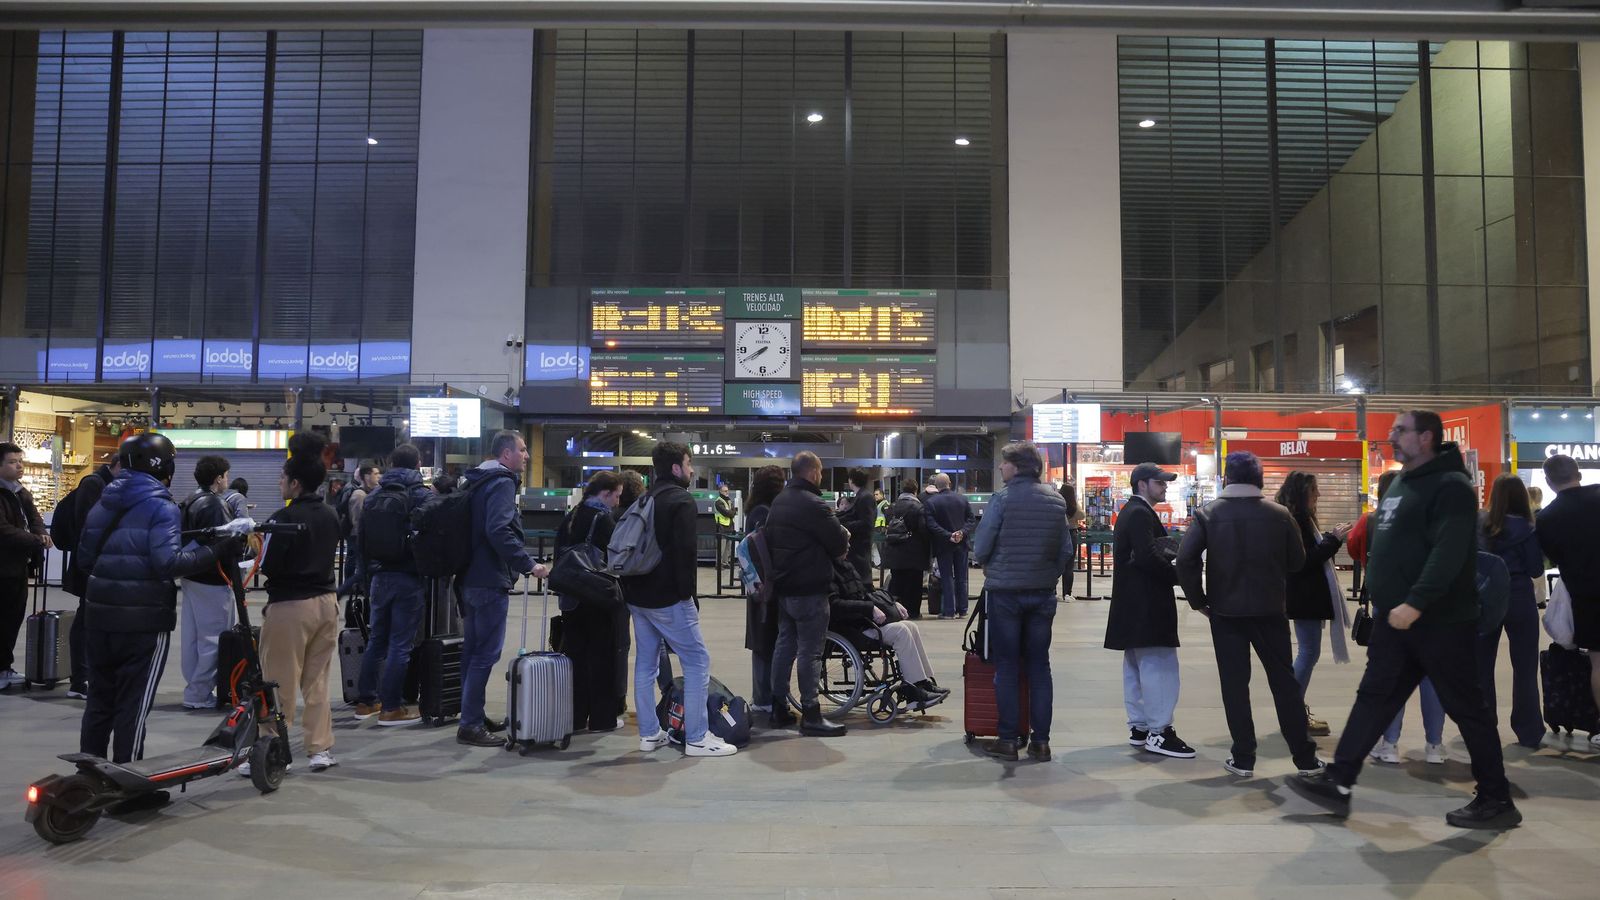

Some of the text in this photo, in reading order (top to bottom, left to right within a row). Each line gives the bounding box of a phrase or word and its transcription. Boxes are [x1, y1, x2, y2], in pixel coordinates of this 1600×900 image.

[743, 293, 785, 302] TRENES ALTA
[746, 303, 782, 312] VELOCIDAD
[740, 346, 747, 354] 9
[759, 366, 767, 374] 6
[743, 390, 783, 399] HIGH SPEED
[751, 399, 775, 409] TRAINS
[1280, 440, 1308, 456] RELAY
[1544, 444, 1600, 460] CHAN
